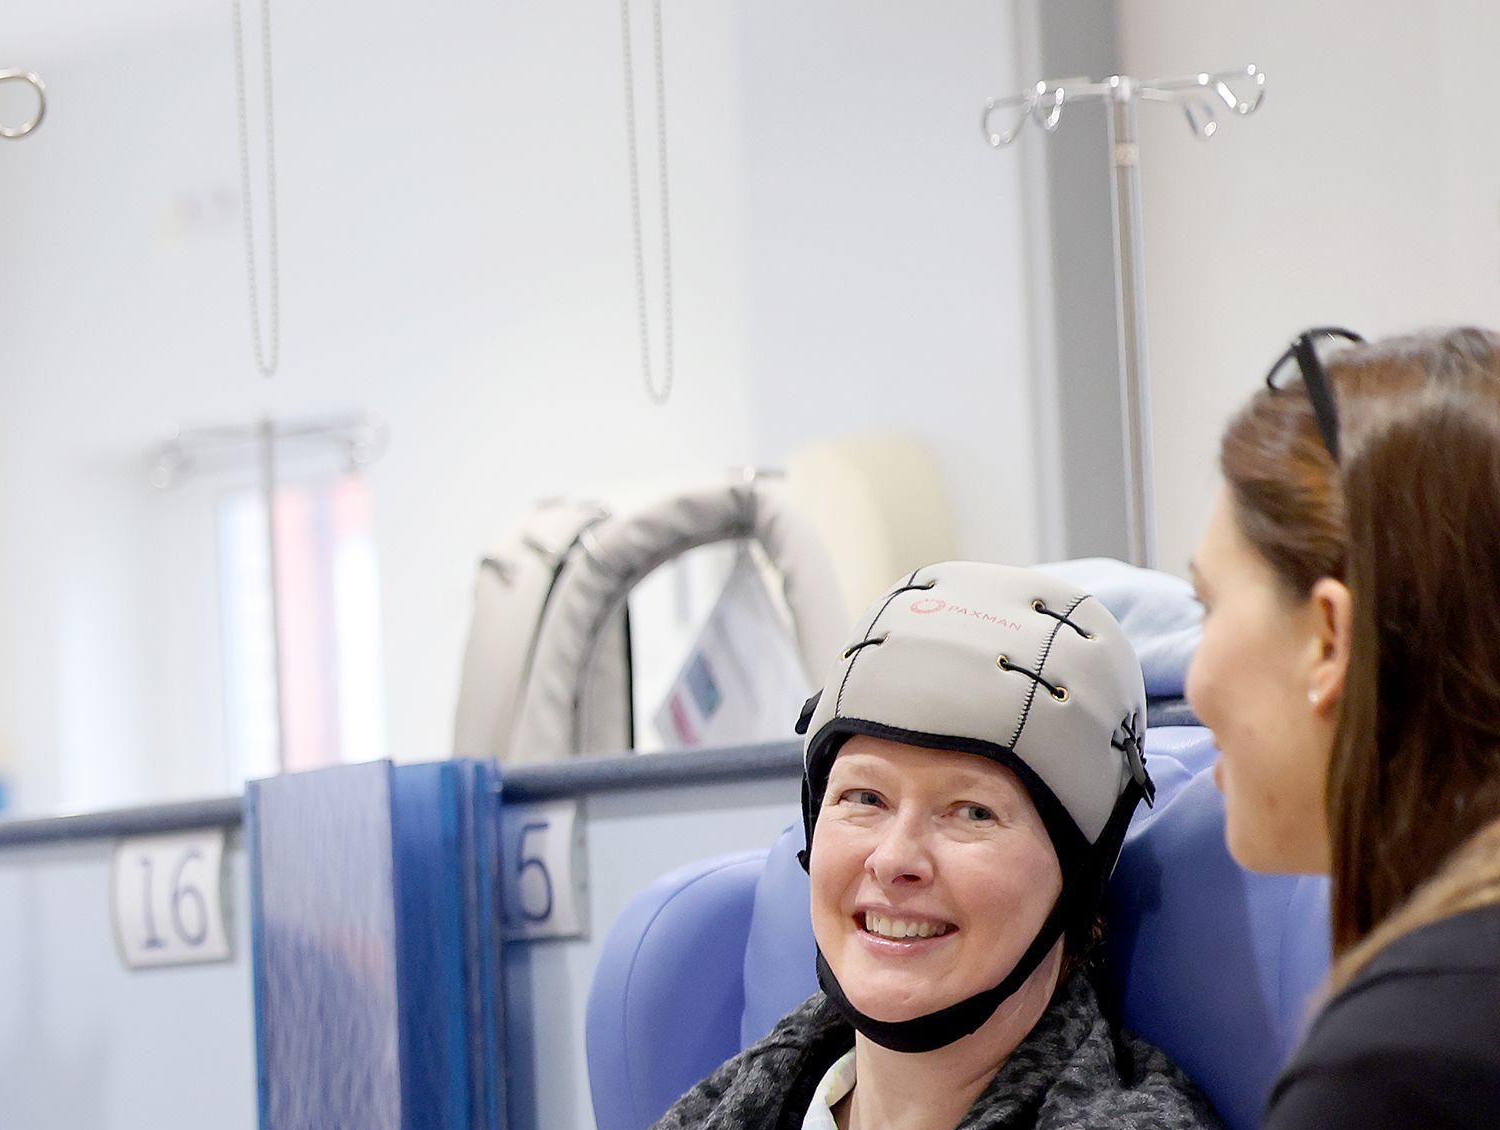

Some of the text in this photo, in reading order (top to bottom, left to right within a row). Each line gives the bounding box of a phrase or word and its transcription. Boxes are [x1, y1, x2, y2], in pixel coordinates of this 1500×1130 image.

[948, 605, 1022, 631] PAXMAN
[137, 849, 210, 951] 16
[501, 821, 554, 923] 5
